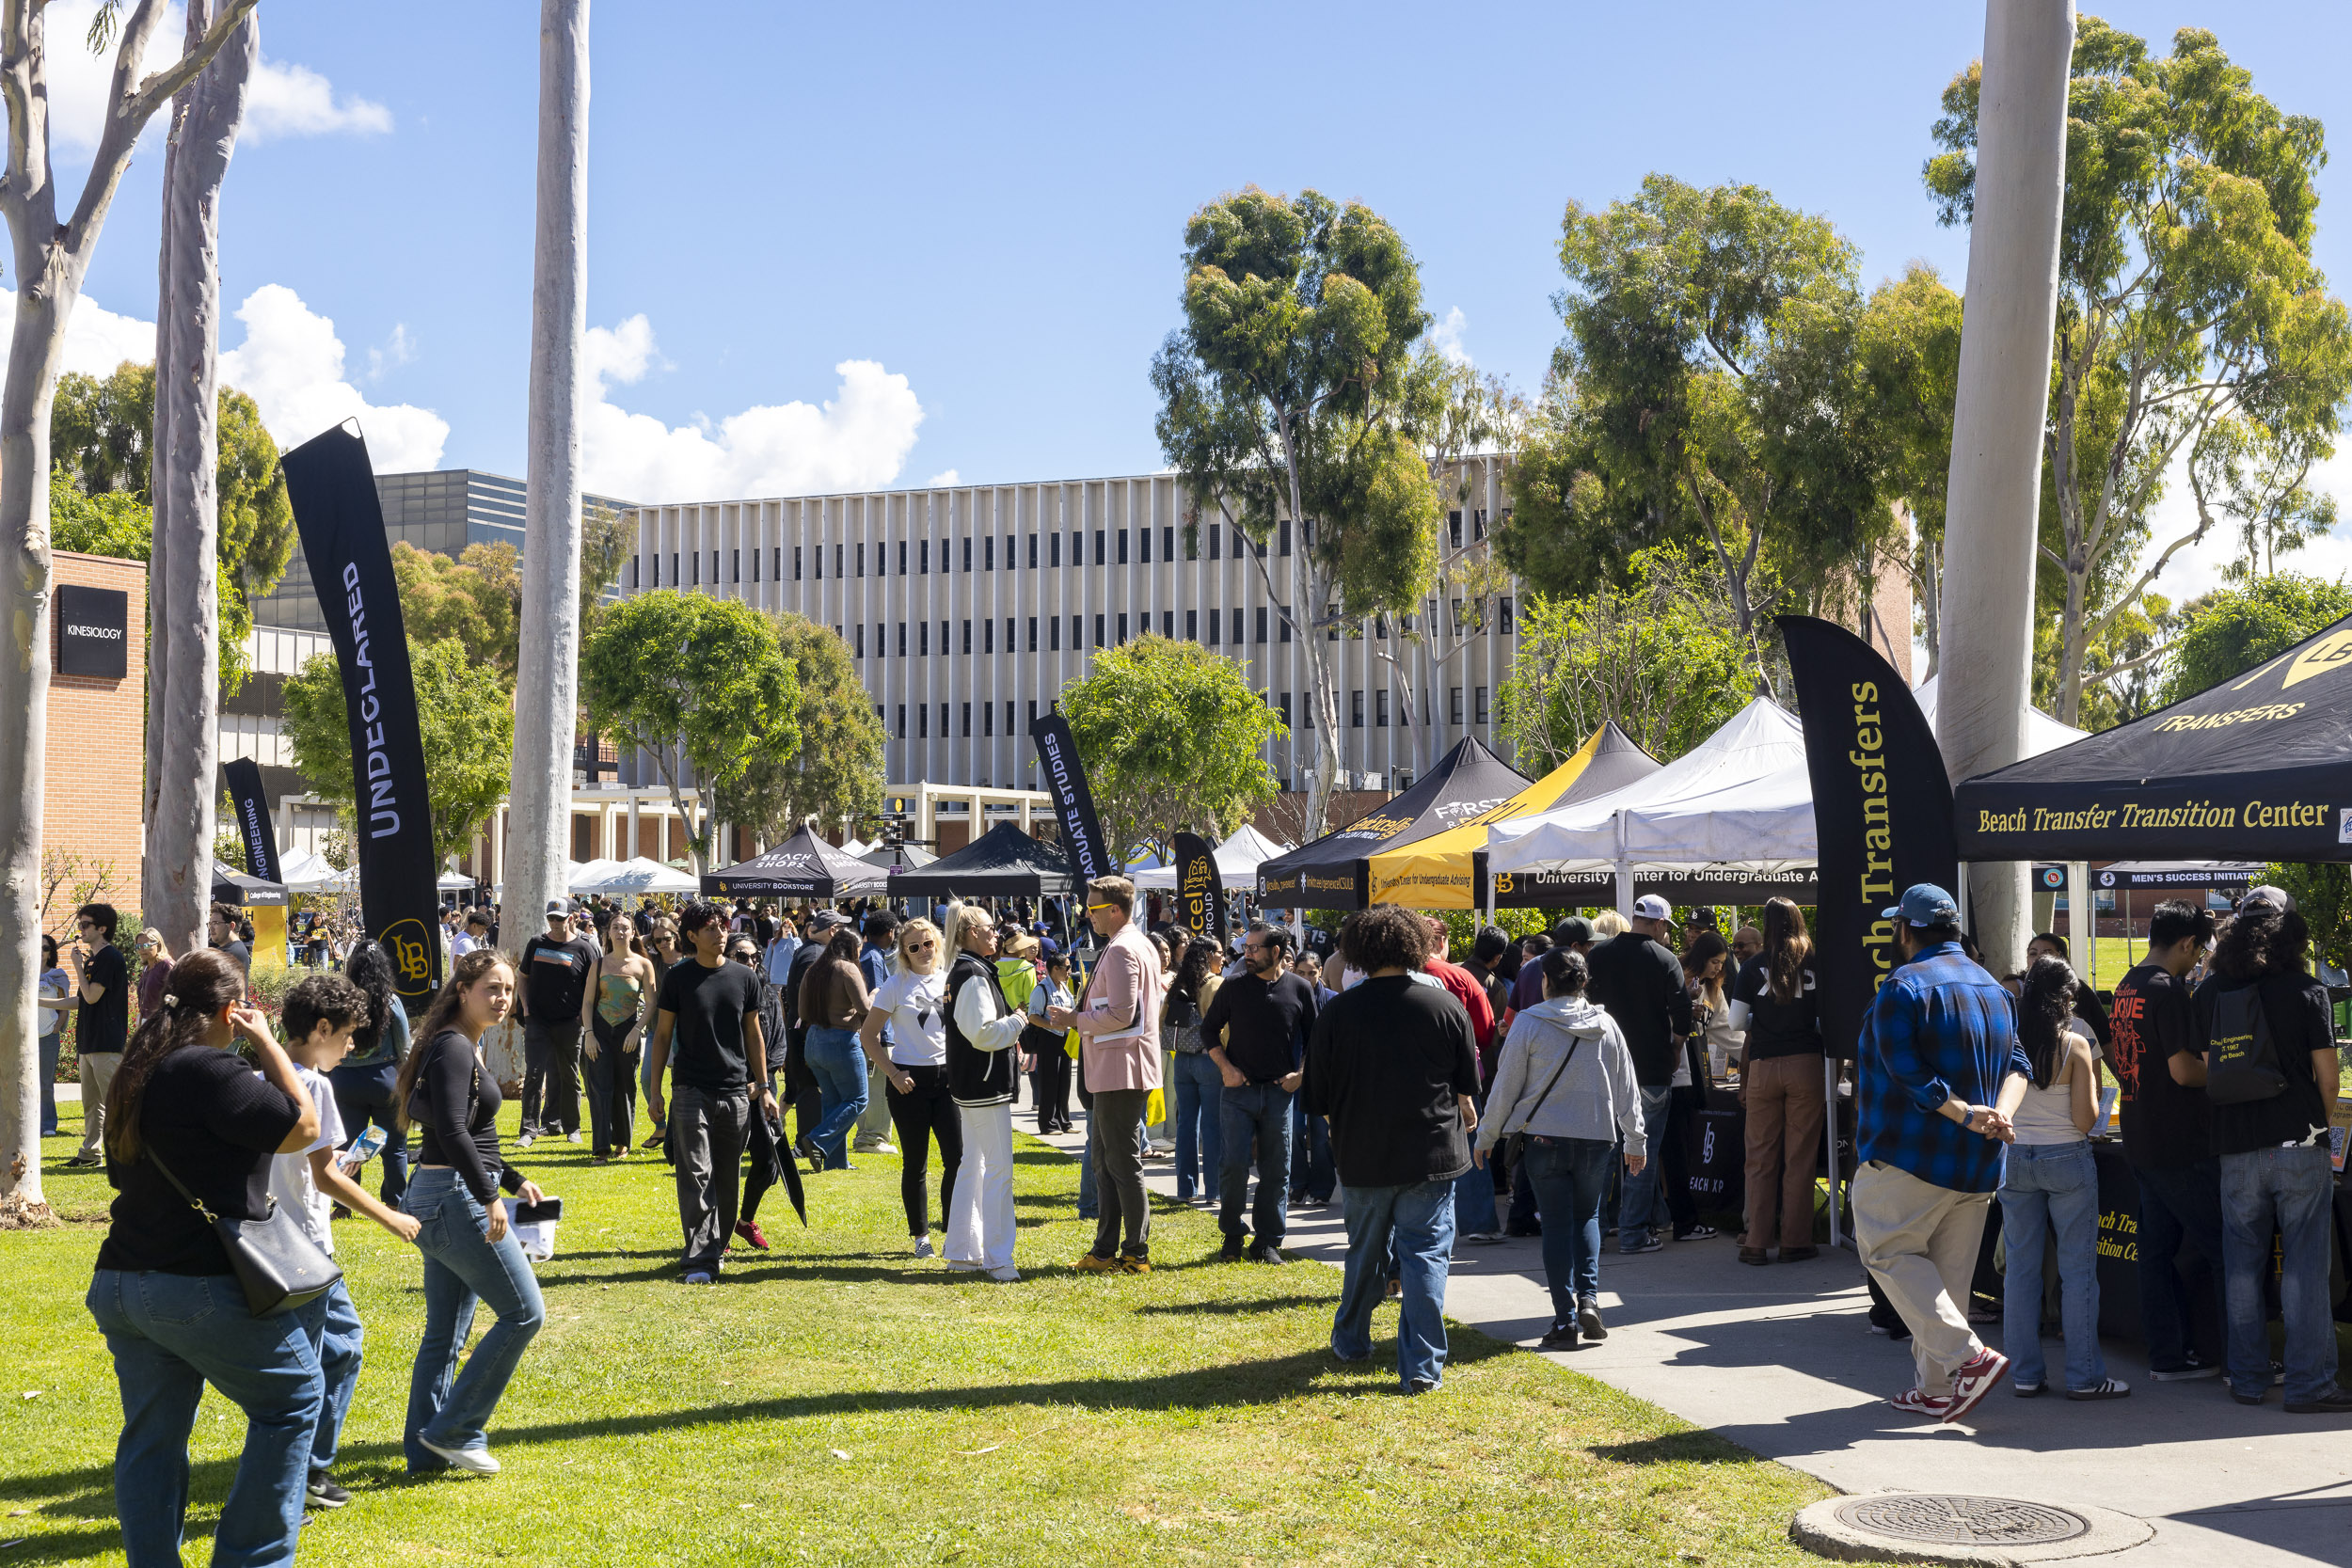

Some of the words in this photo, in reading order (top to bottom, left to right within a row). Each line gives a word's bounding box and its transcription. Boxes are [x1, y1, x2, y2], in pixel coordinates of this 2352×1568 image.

[68, 625, 122, 640] KINESIOLOGY
[342, 562, 401, 839] UNDECLARED
[2153, 703, 2306, 732] TRANSFERS
[1044, 732, 1075, 806] STUDIES
[1849, 681, 1895, 905] Transfers
[1978, 807, 2026, 832] Beach
[2033, 803, 2117, 832] Transfer
[2120, 800, 2236, 828] Transition
[2243, 800, 2329, 828] Center
[1067, 807, 1098, 882] RADUATE
[761, 852, 812, 862] BEACH
[755, 861, 806, 869] SHOPS
[873, 880, 888, 889] BOOKS
[1400, 875, 1412, 886] Center
[1419, 873, 1450, 887] Undergraduate
[1450, 873, 1471, 888] Advising
[1535, 870, 1610, 884] University
[1634, 871, 1664, 882] nter
[1668, 870, 1690, 881] for
[1694, 870, 1804, 884] Undergraduate
[2131, 874, 2164, 883] MEN'S
[2165, 873, 2212, 882] SUCCESS
[772, 882, 815, 891] BOOKSTORE
[1311, 930, 1327, 944] 75
[390, 934, 429, 983] LB
[2112, 997, 2145, 1020] IQUE
[2222, 1034, 2253, 1044] Engineering
[1690, 1177, 1708, 1193] EACH
[1712, 1180, 1724, 1193] XP
